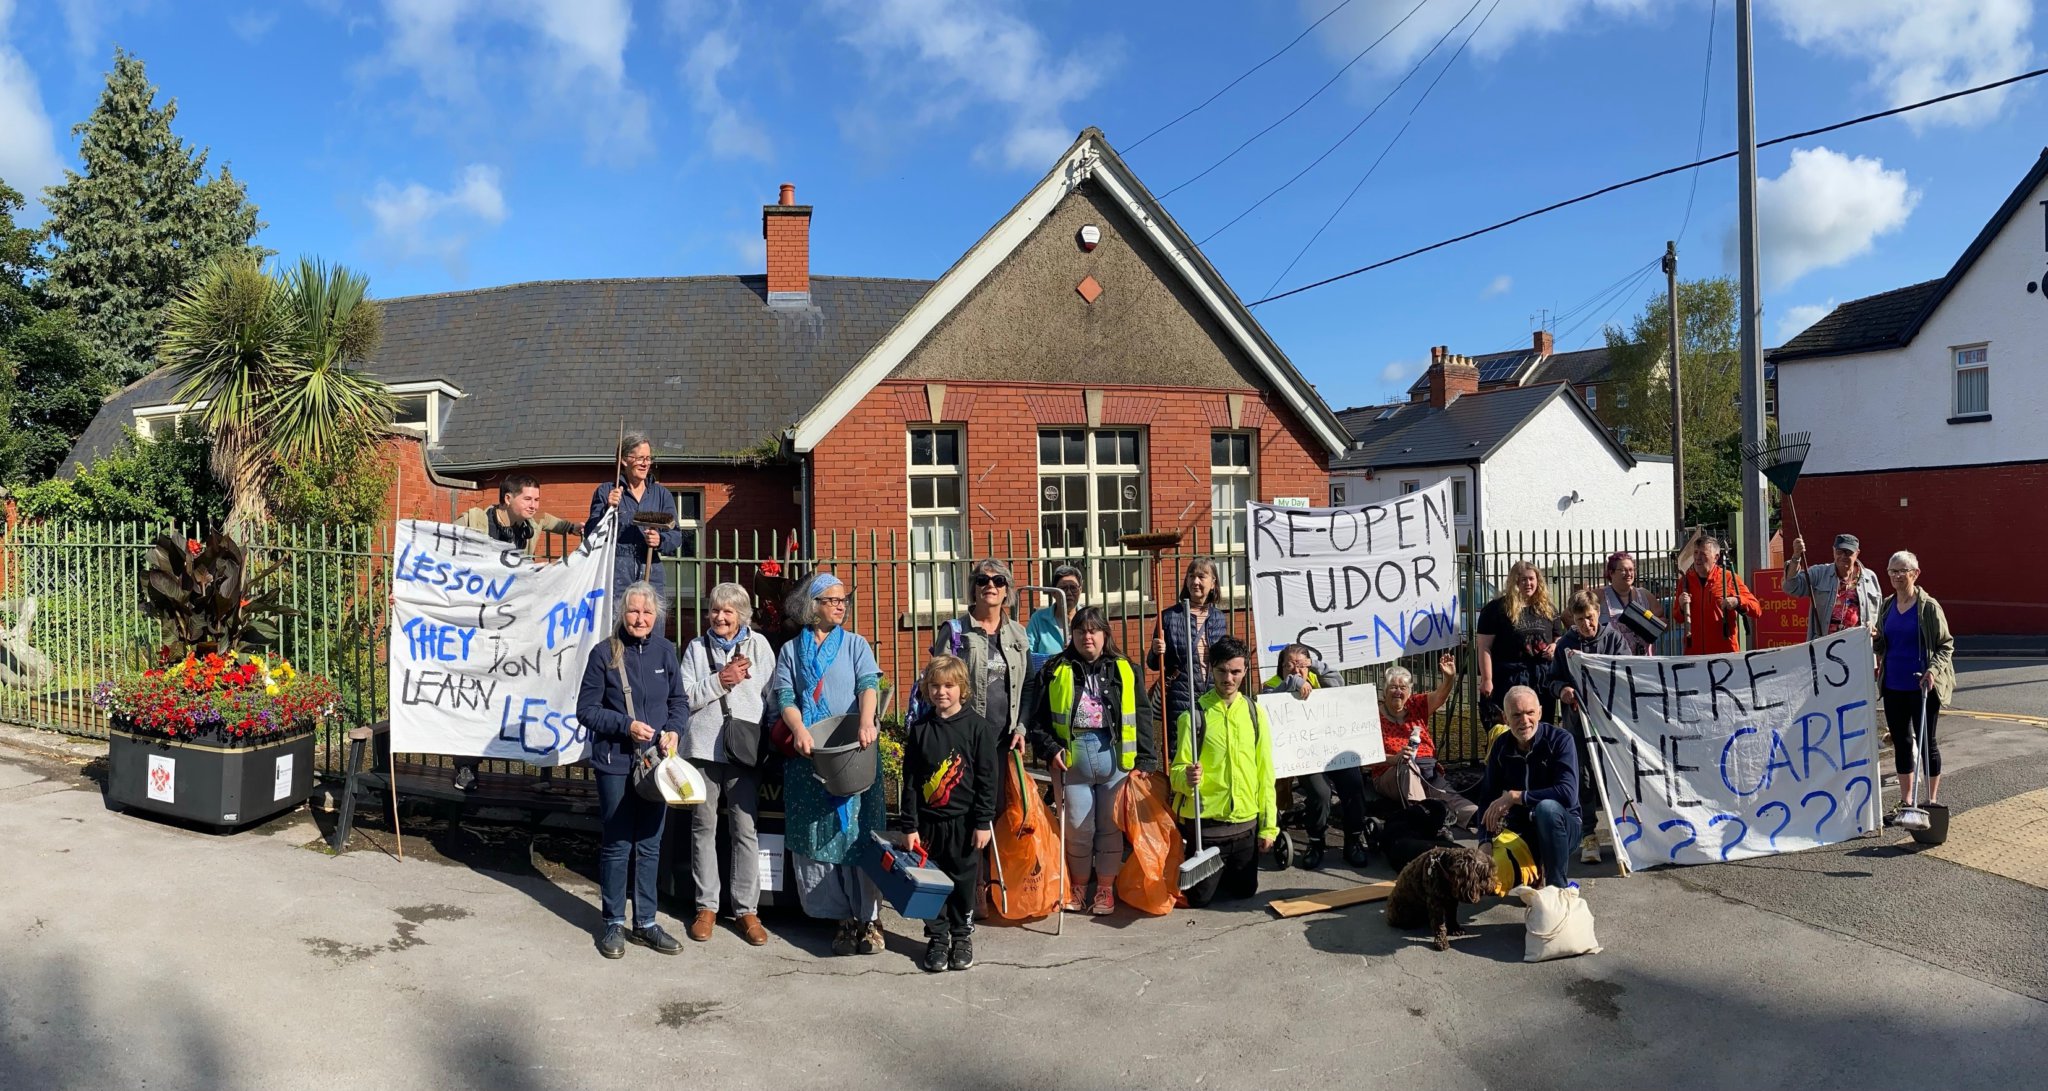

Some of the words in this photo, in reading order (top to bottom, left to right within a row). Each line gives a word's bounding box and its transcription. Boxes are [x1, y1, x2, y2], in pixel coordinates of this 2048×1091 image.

[1253, 489, 1450, 561] RE-OPEN
[1279, 498, 1290, 508] My
[1291, 498, 1305, 508] Day
[395, 542, 517, 600] LESSON
[1256, 556, 1440, 617] TUDOR
[478, 602, 517, 630] IS
[540, 588, 605, 649] THAT
[1759, 597, 1797, 613] Carpets
[1781, 614, 1789, 627] &
[403, 616, 477, 661] THEY
[402, 668, 497, 711] LEARN
[1807, 638, 1849, 697] IS
[500, 694, 593, 756] LESSO
[1265, 702, 1295, 727] WE
[1301, 701, 1343, 722] WILL
[1275, 728, 1318, 748] CARE
[1324, 725, 1347, 738] AND
[1296, 744, 1318, 759] OUR
[1322, 743, 1340, 757] HUB
[1584, 733, 1703, 809] THE
[1720, 699, 1871, 797] CARE
